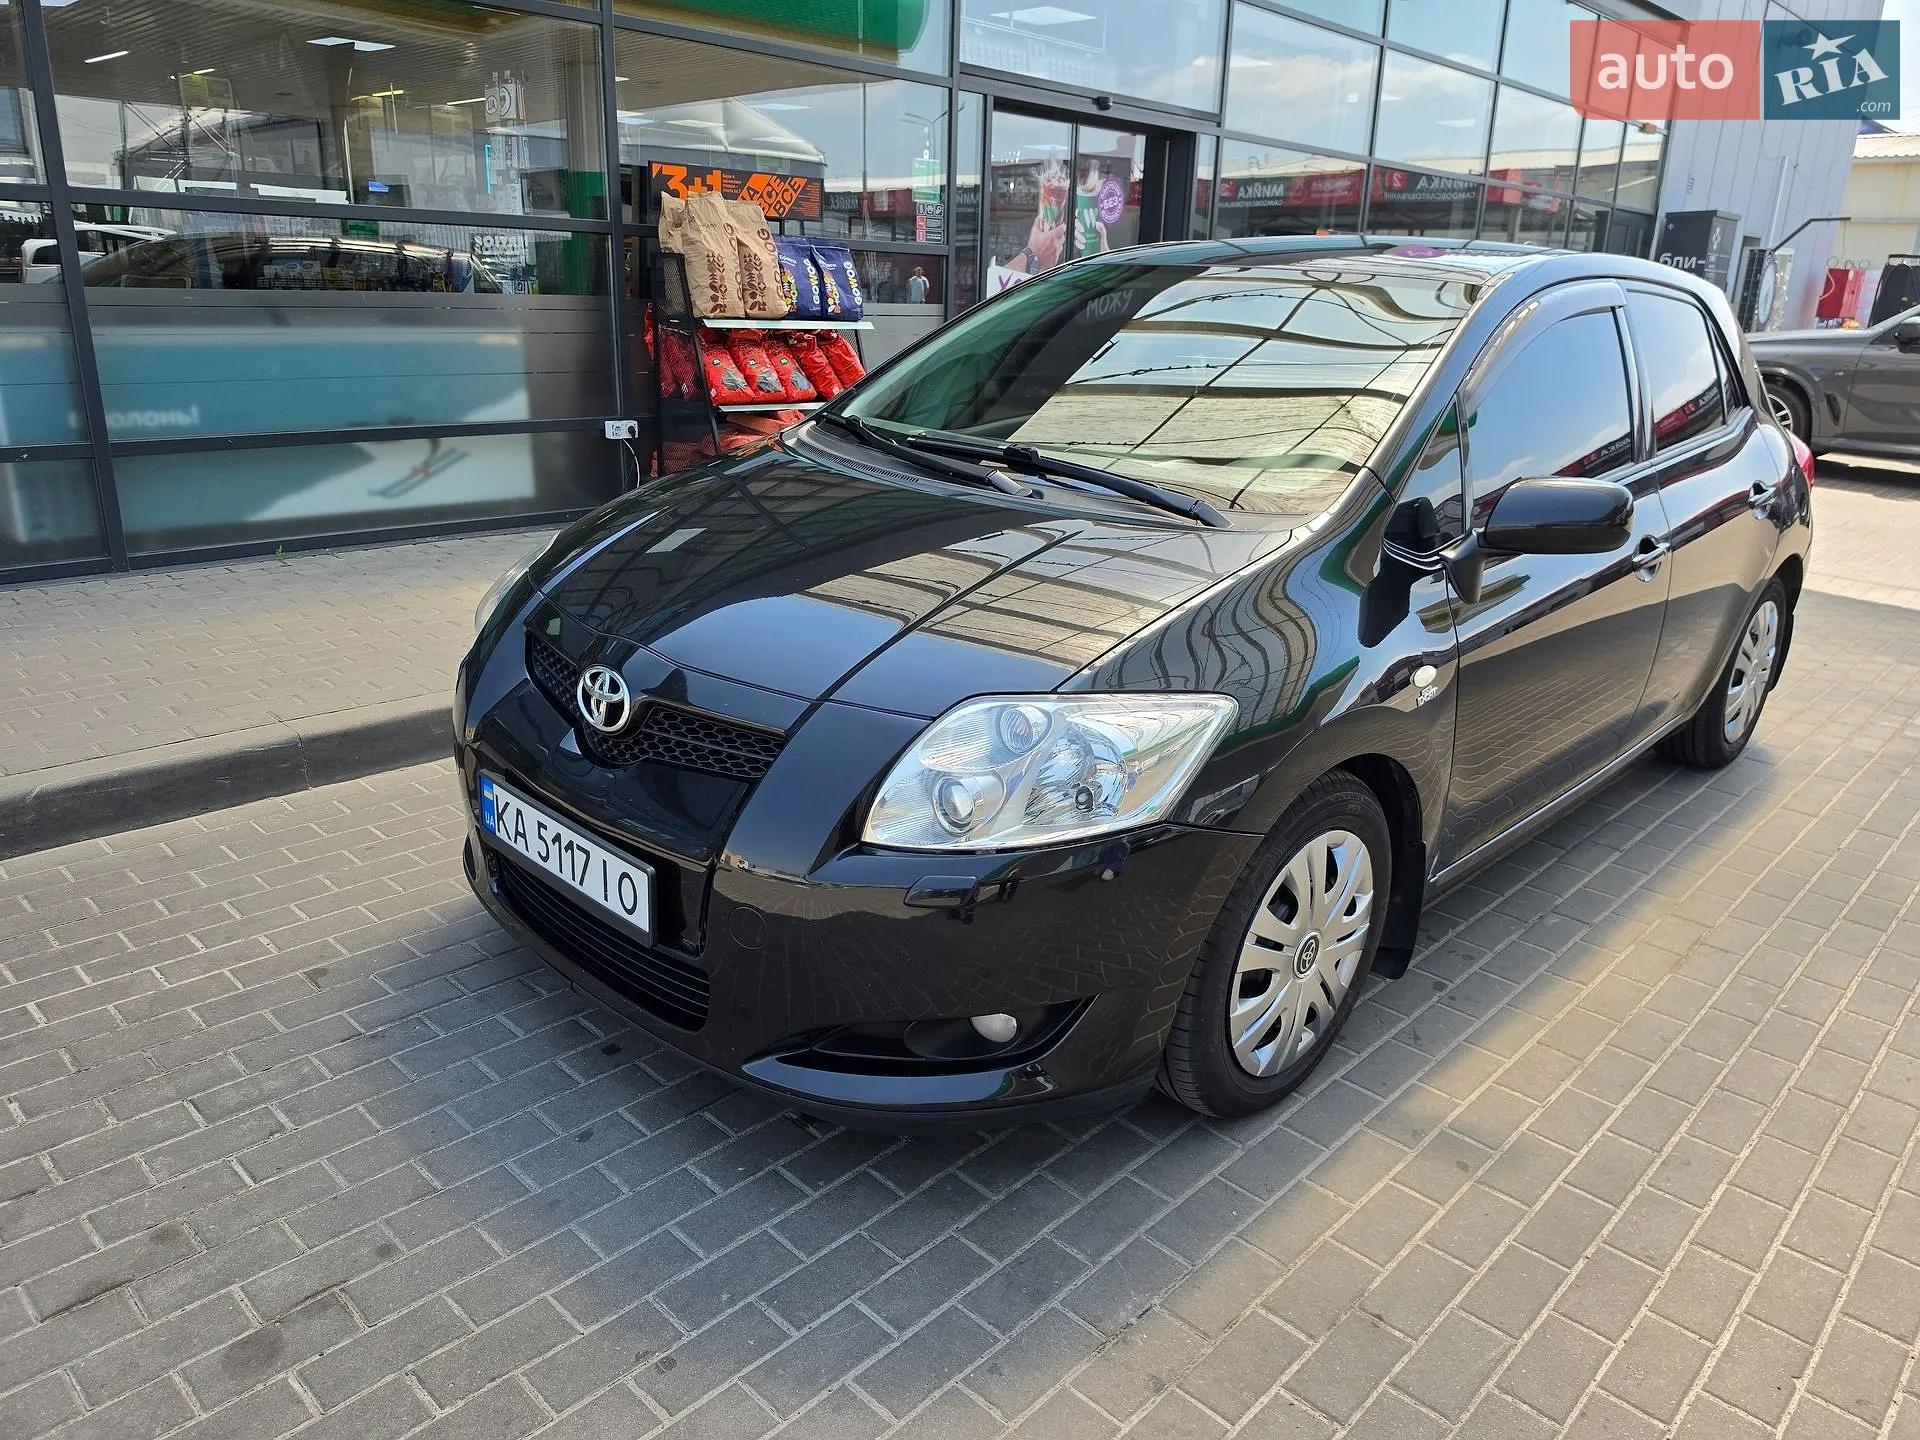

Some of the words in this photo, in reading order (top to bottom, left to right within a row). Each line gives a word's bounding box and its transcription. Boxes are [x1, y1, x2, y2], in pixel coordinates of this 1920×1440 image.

[803, 257, 821, 305] GOWOG
[843, 260, 864, 306] GOWOG
[484, 811, 495, 828] UA
[495, 794, 529, 853] KA
[536, 819, 591, 887] 5117
[602, 858, 638, 916] IO
